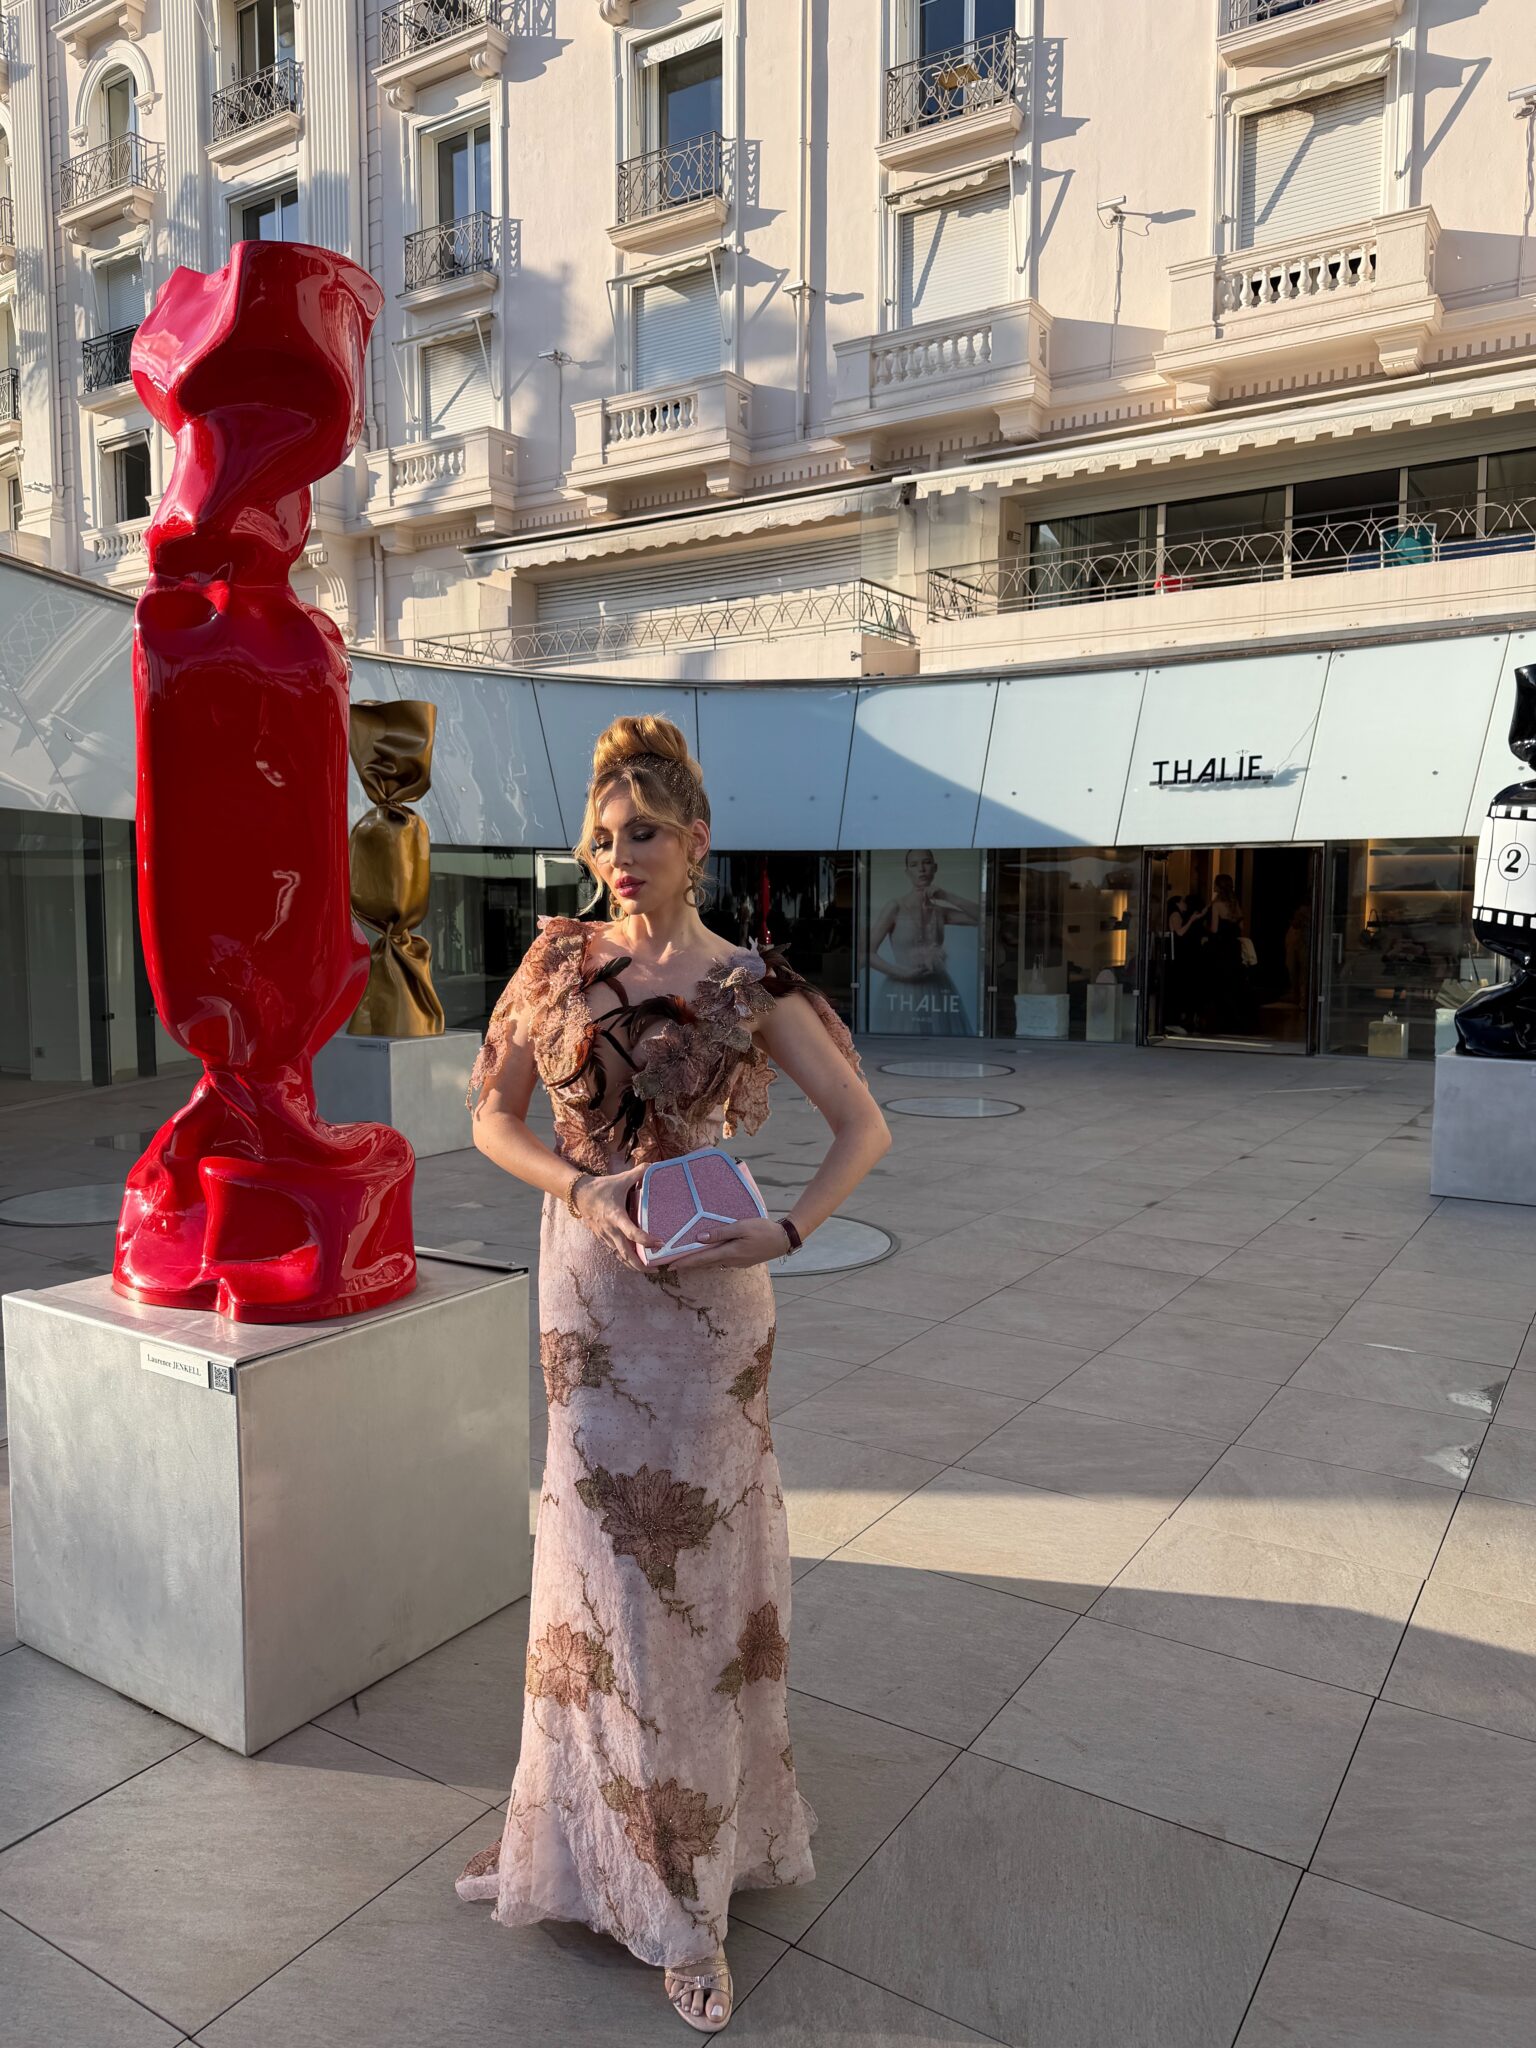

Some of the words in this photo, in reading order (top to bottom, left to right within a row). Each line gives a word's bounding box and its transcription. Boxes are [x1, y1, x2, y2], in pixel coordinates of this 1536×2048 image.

[1152, 755, 1263, 785] THALIE
[1504, 849, 1522, 873] 2
[886, 993, 960, 1013] THALIE
[147, 1353, 172, 1368] Laurence
[172, 1361, 202, 1376] JENKELL
